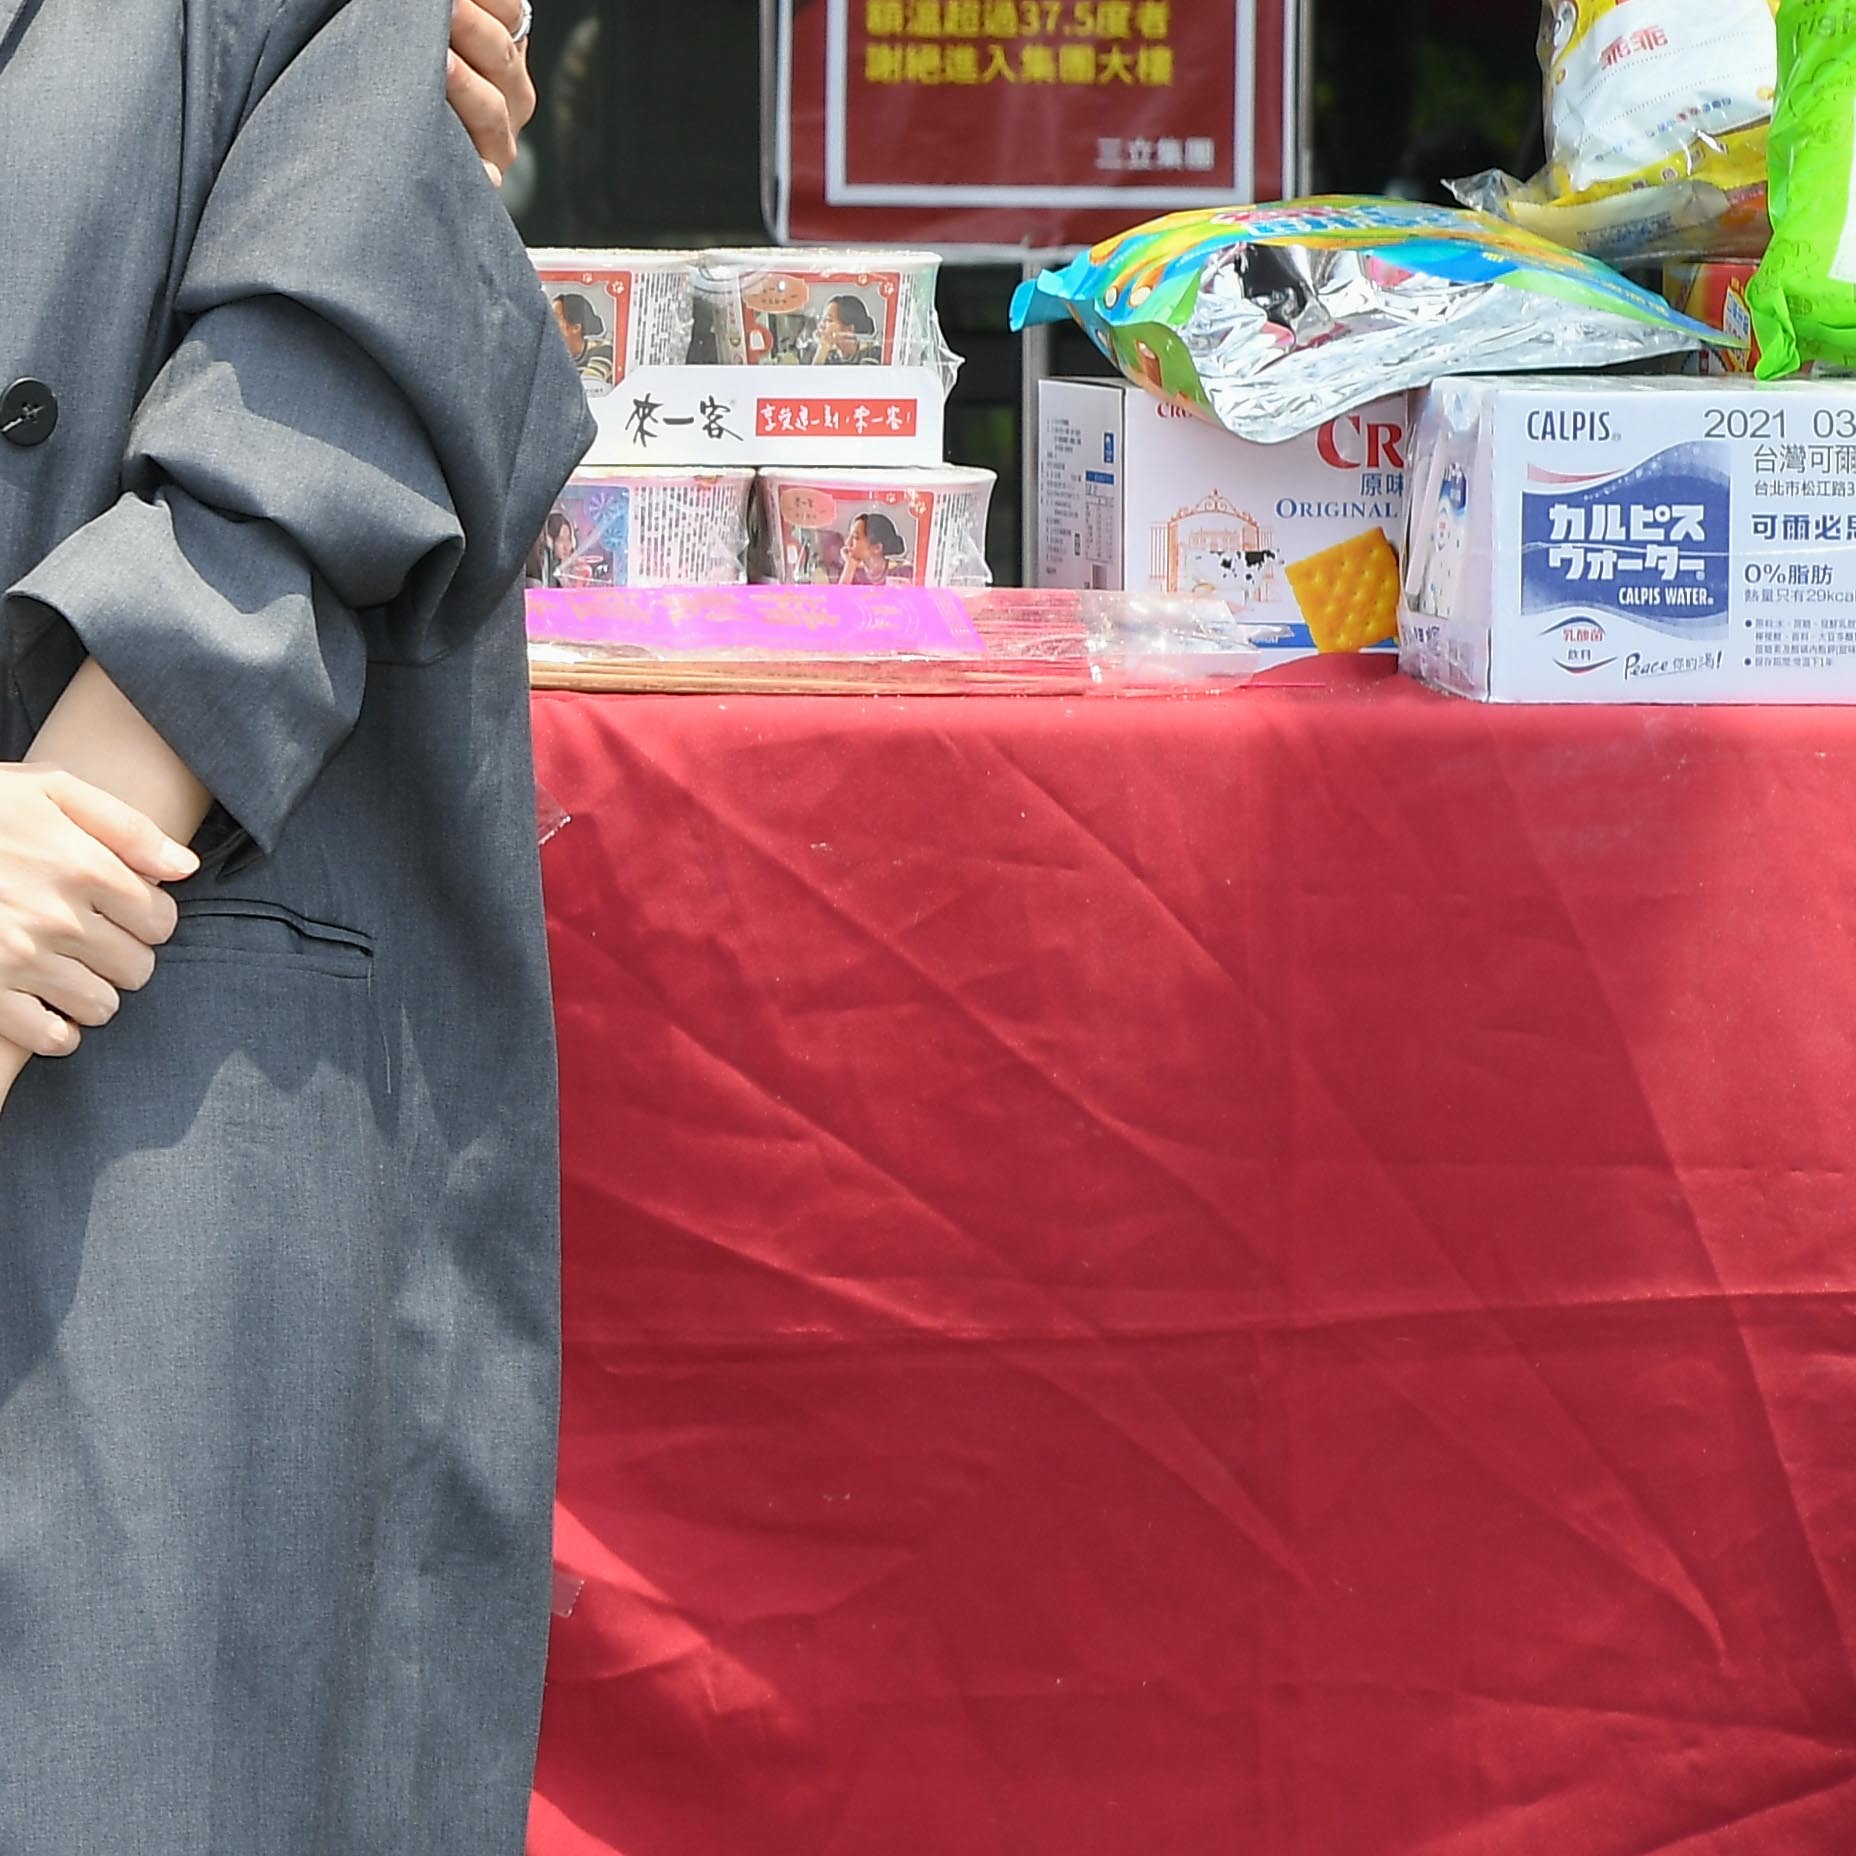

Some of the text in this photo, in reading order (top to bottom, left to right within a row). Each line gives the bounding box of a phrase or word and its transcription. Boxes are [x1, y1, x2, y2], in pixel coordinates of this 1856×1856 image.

[865, 43, 1174, 85] 謝絕進入集團大樓
[1095, 136, 1215, 171] 三立集團
[625, 392, 744, 447] 來一客
[1527, 410, 1611, 441] CALPIS
[1704, 408, 1856, 438] 2021 03
[1360, 472, 1404, 496] 原味
[1275, 498, 1398, 519] ORIGINAL
[1548, 502, 1705, 542] カルピス
[1548, 546, 1705, 581] ウォーター
[1744, 563, 1833, 585] 0%脂肪
[1619, 587, 1661, 606] CALPIS
[1624, 651, 1669, 681] Peace
